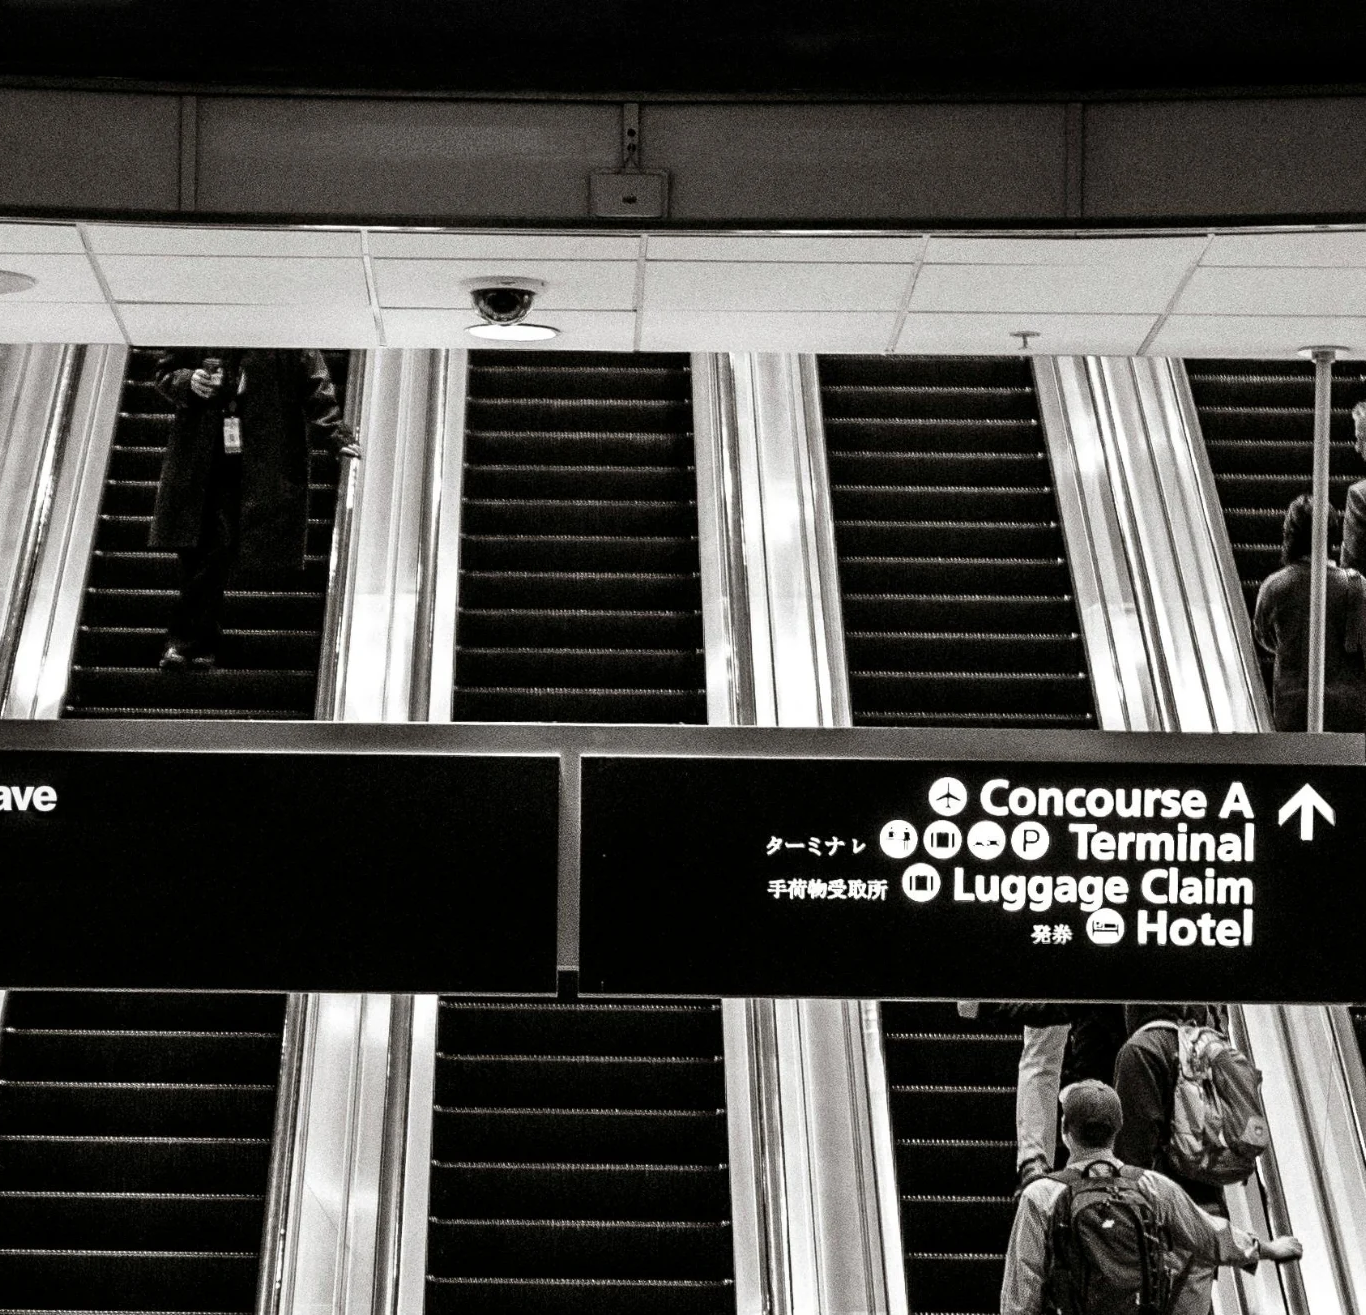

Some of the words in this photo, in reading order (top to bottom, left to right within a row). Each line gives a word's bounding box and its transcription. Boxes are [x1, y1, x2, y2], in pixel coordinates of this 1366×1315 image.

[979, 779, 1208, 820] Concourse
[1217, 781, 1255, 819] A
[1068, 822, 1255, 862] Terminal
[766, 877, 889, 901] 手荷物受取所
[953, 866, 1130, 913] Luggage
[1140, 866, 1254, 906] Claim
[1137, 908, 1254, 948] Hotel
